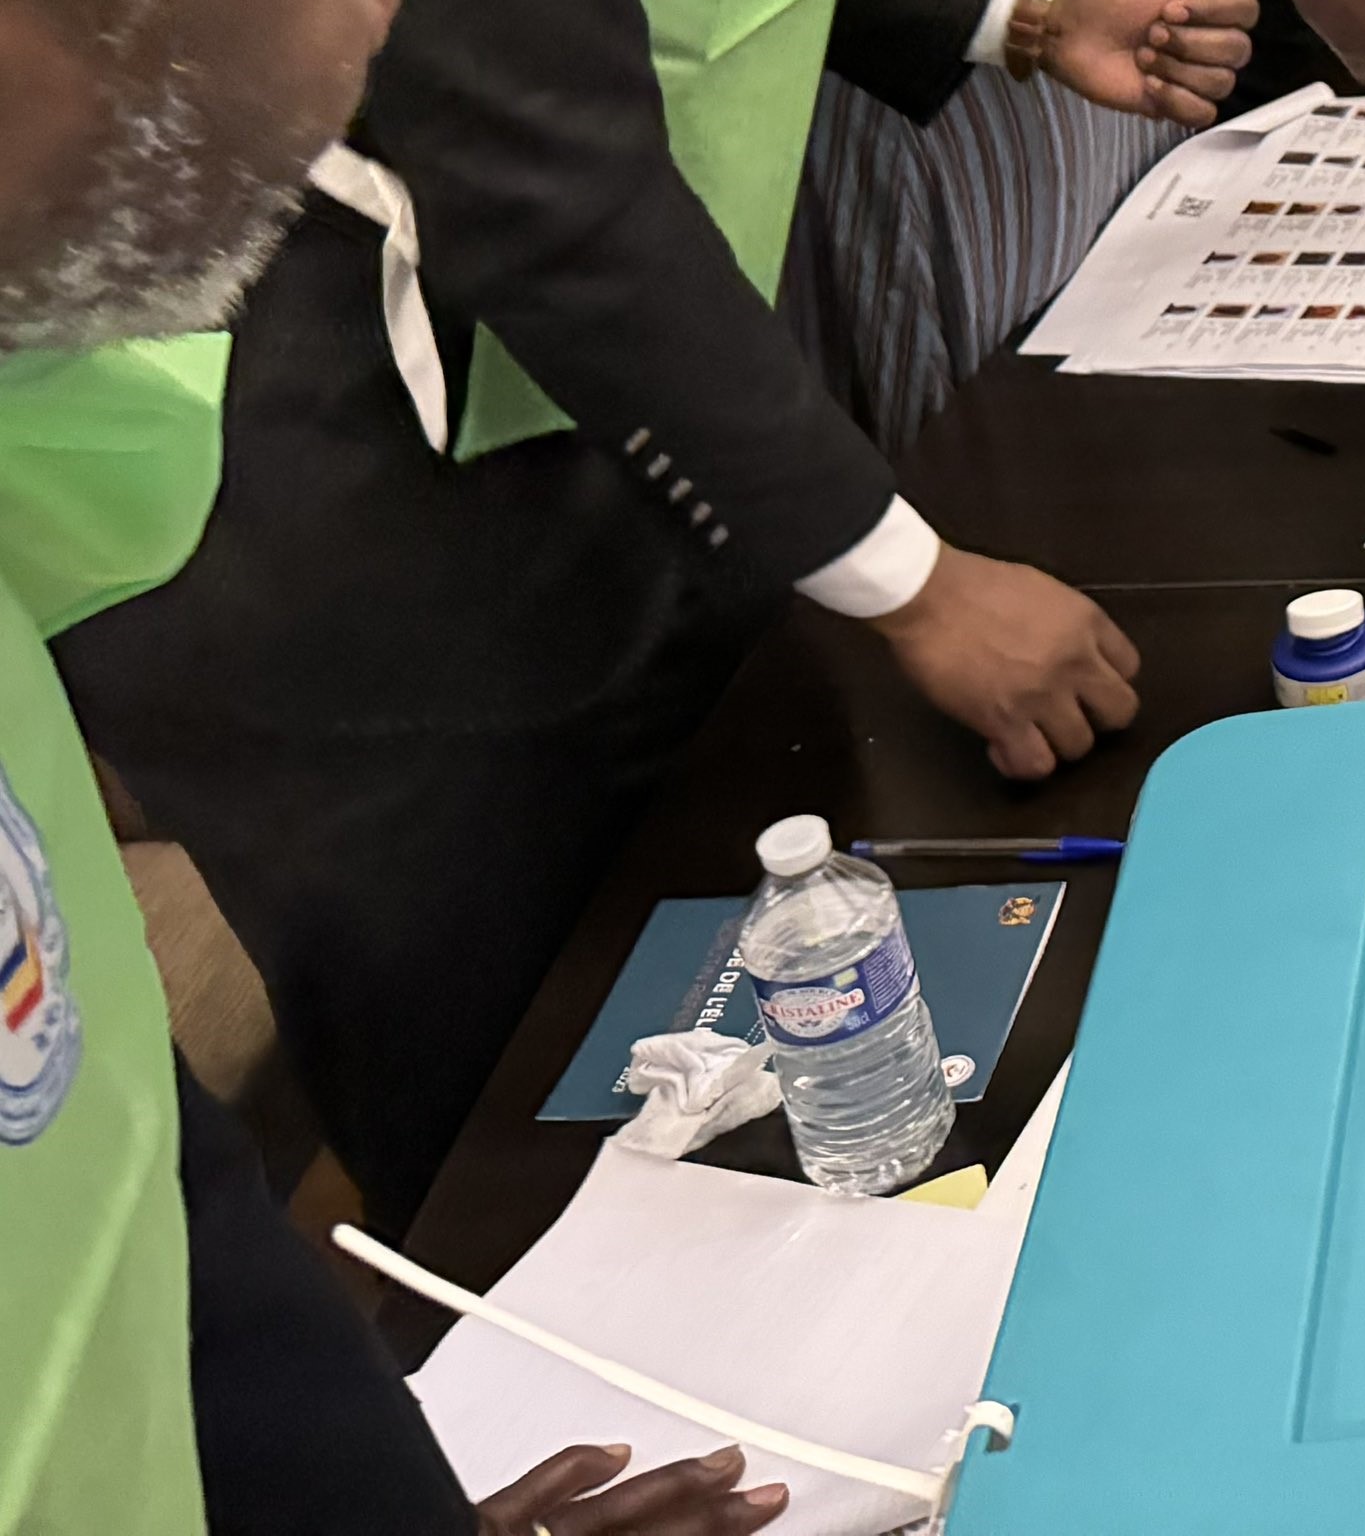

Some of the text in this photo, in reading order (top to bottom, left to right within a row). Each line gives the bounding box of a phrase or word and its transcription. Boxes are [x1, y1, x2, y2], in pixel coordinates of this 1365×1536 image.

[712, 971, 741, 993] DE
[694, 997, 728, 1031] L'ÉL
[765, 990, 862, 1018] RISTALINE
